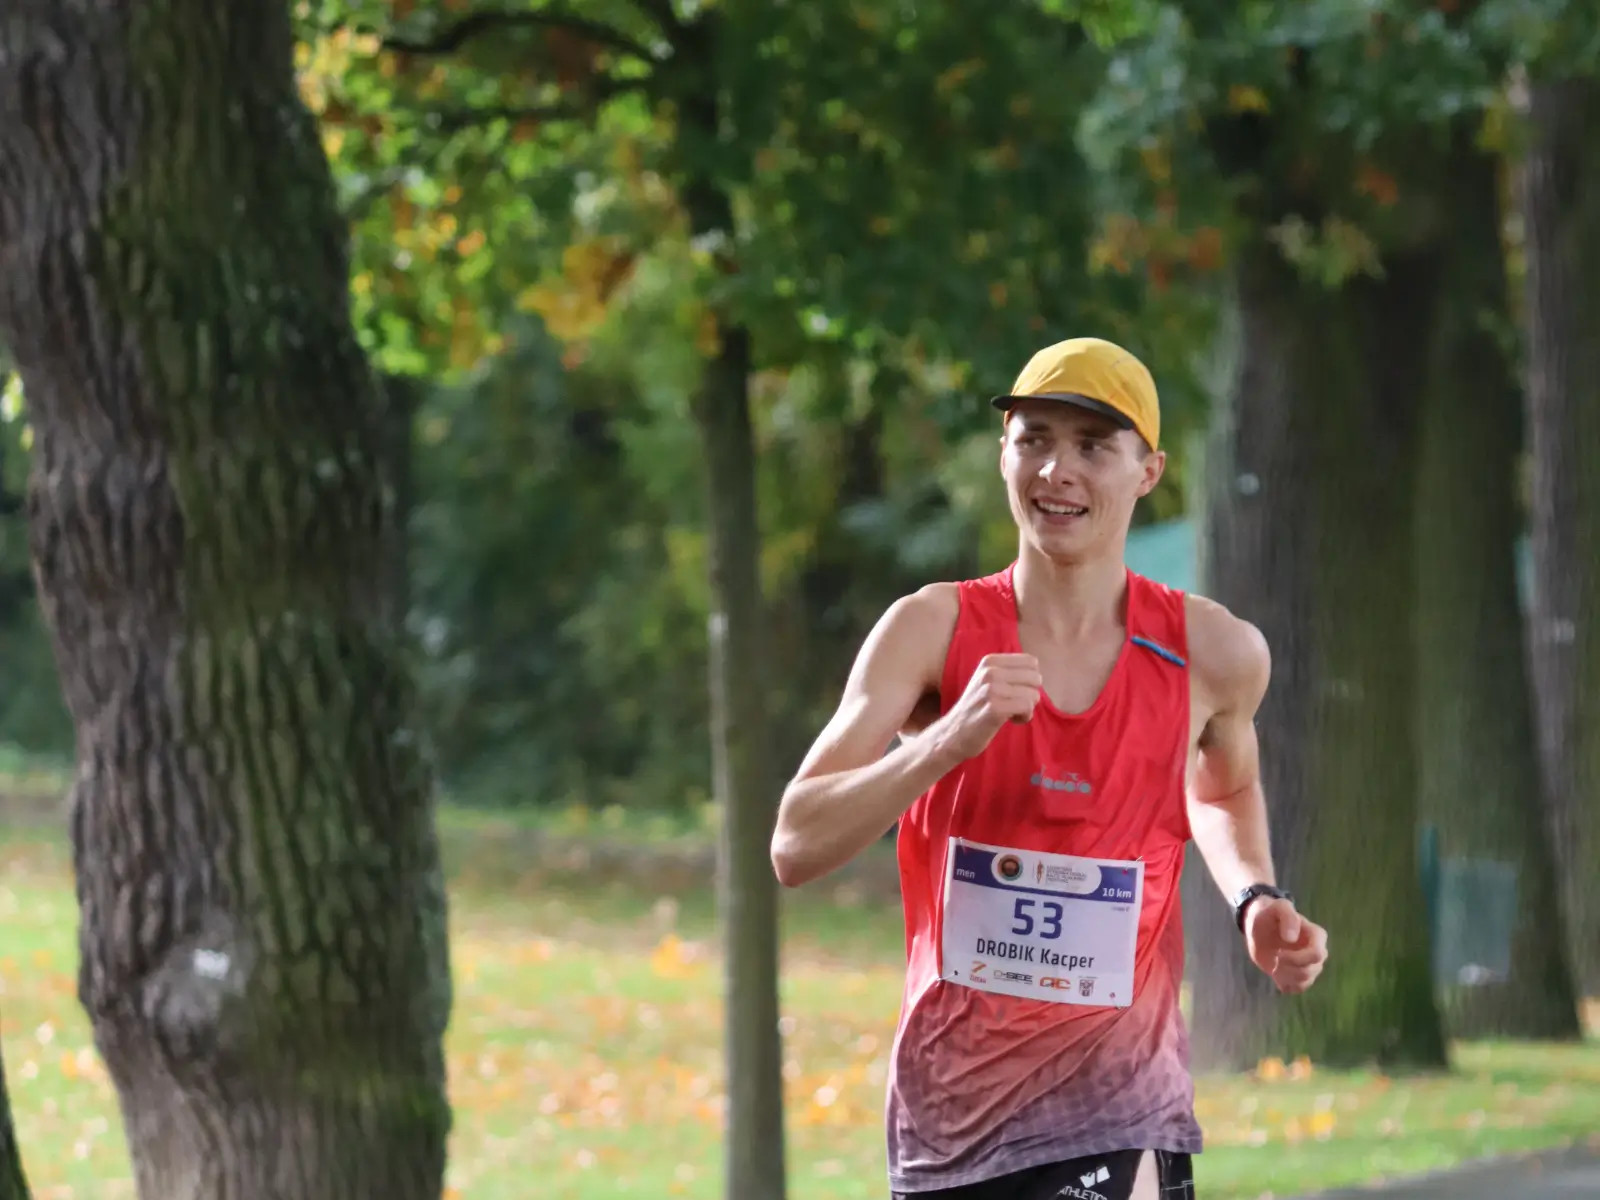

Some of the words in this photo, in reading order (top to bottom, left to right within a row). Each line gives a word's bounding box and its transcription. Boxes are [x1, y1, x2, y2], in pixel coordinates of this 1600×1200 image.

[956, 868, 976, 879] men
[1102, 887, 1115, 897] 10
[1116, 888, 1132, 898] km
[1012, 897, 1064, 940] 53
[976, 938, 1035, 962] DROBIK
[1040, 948, 1095, 972] Kacper
